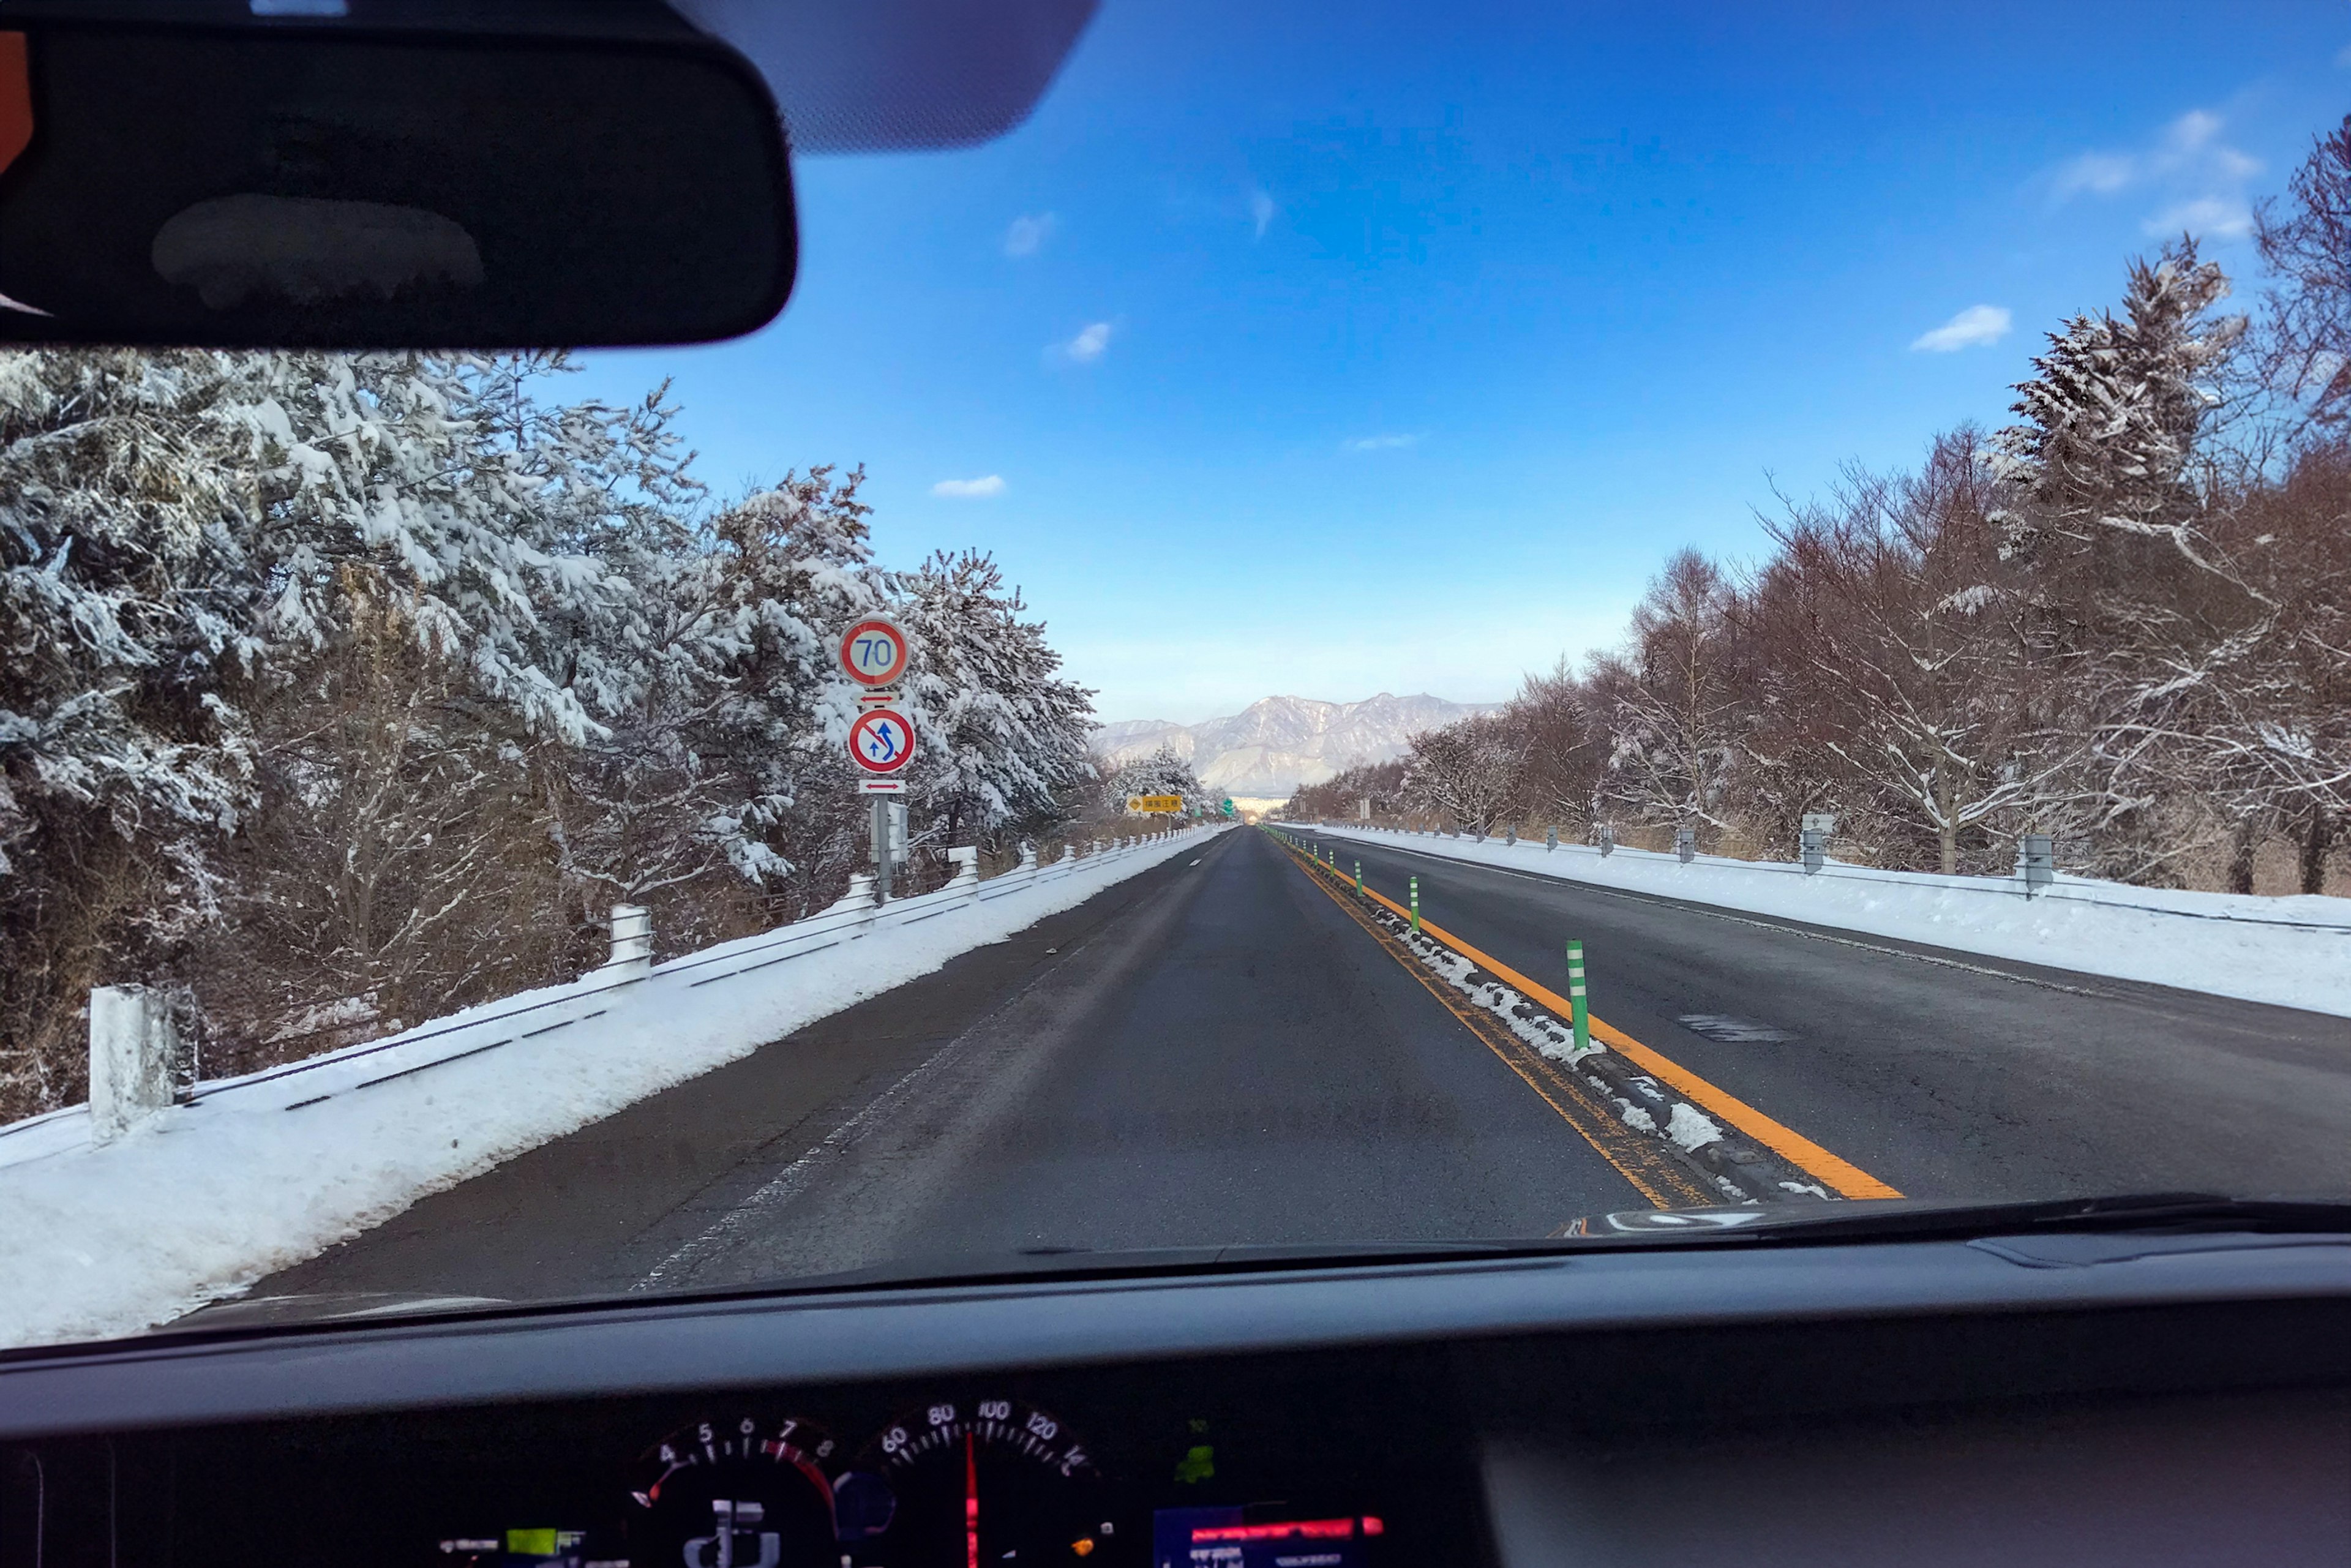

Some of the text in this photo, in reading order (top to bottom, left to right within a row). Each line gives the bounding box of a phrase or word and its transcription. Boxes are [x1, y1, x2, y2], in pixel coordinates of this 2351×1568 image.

[856, 639, 891, 667] 70
[928, 1405, 955, 1425] 80
[978, 1401, 1010, 1419] 100
[699, 1423, 714, 1442] 5
[740, 1418, 755, 1434] 6
[779, 1419, 797, 1438] 7
[1026, 1412, 1057, 1440] 120
[816, 1439, 834, 1458] 8
[882, 1427, 907, 1453] 60
[659, 1443, 676, 1462] 4
